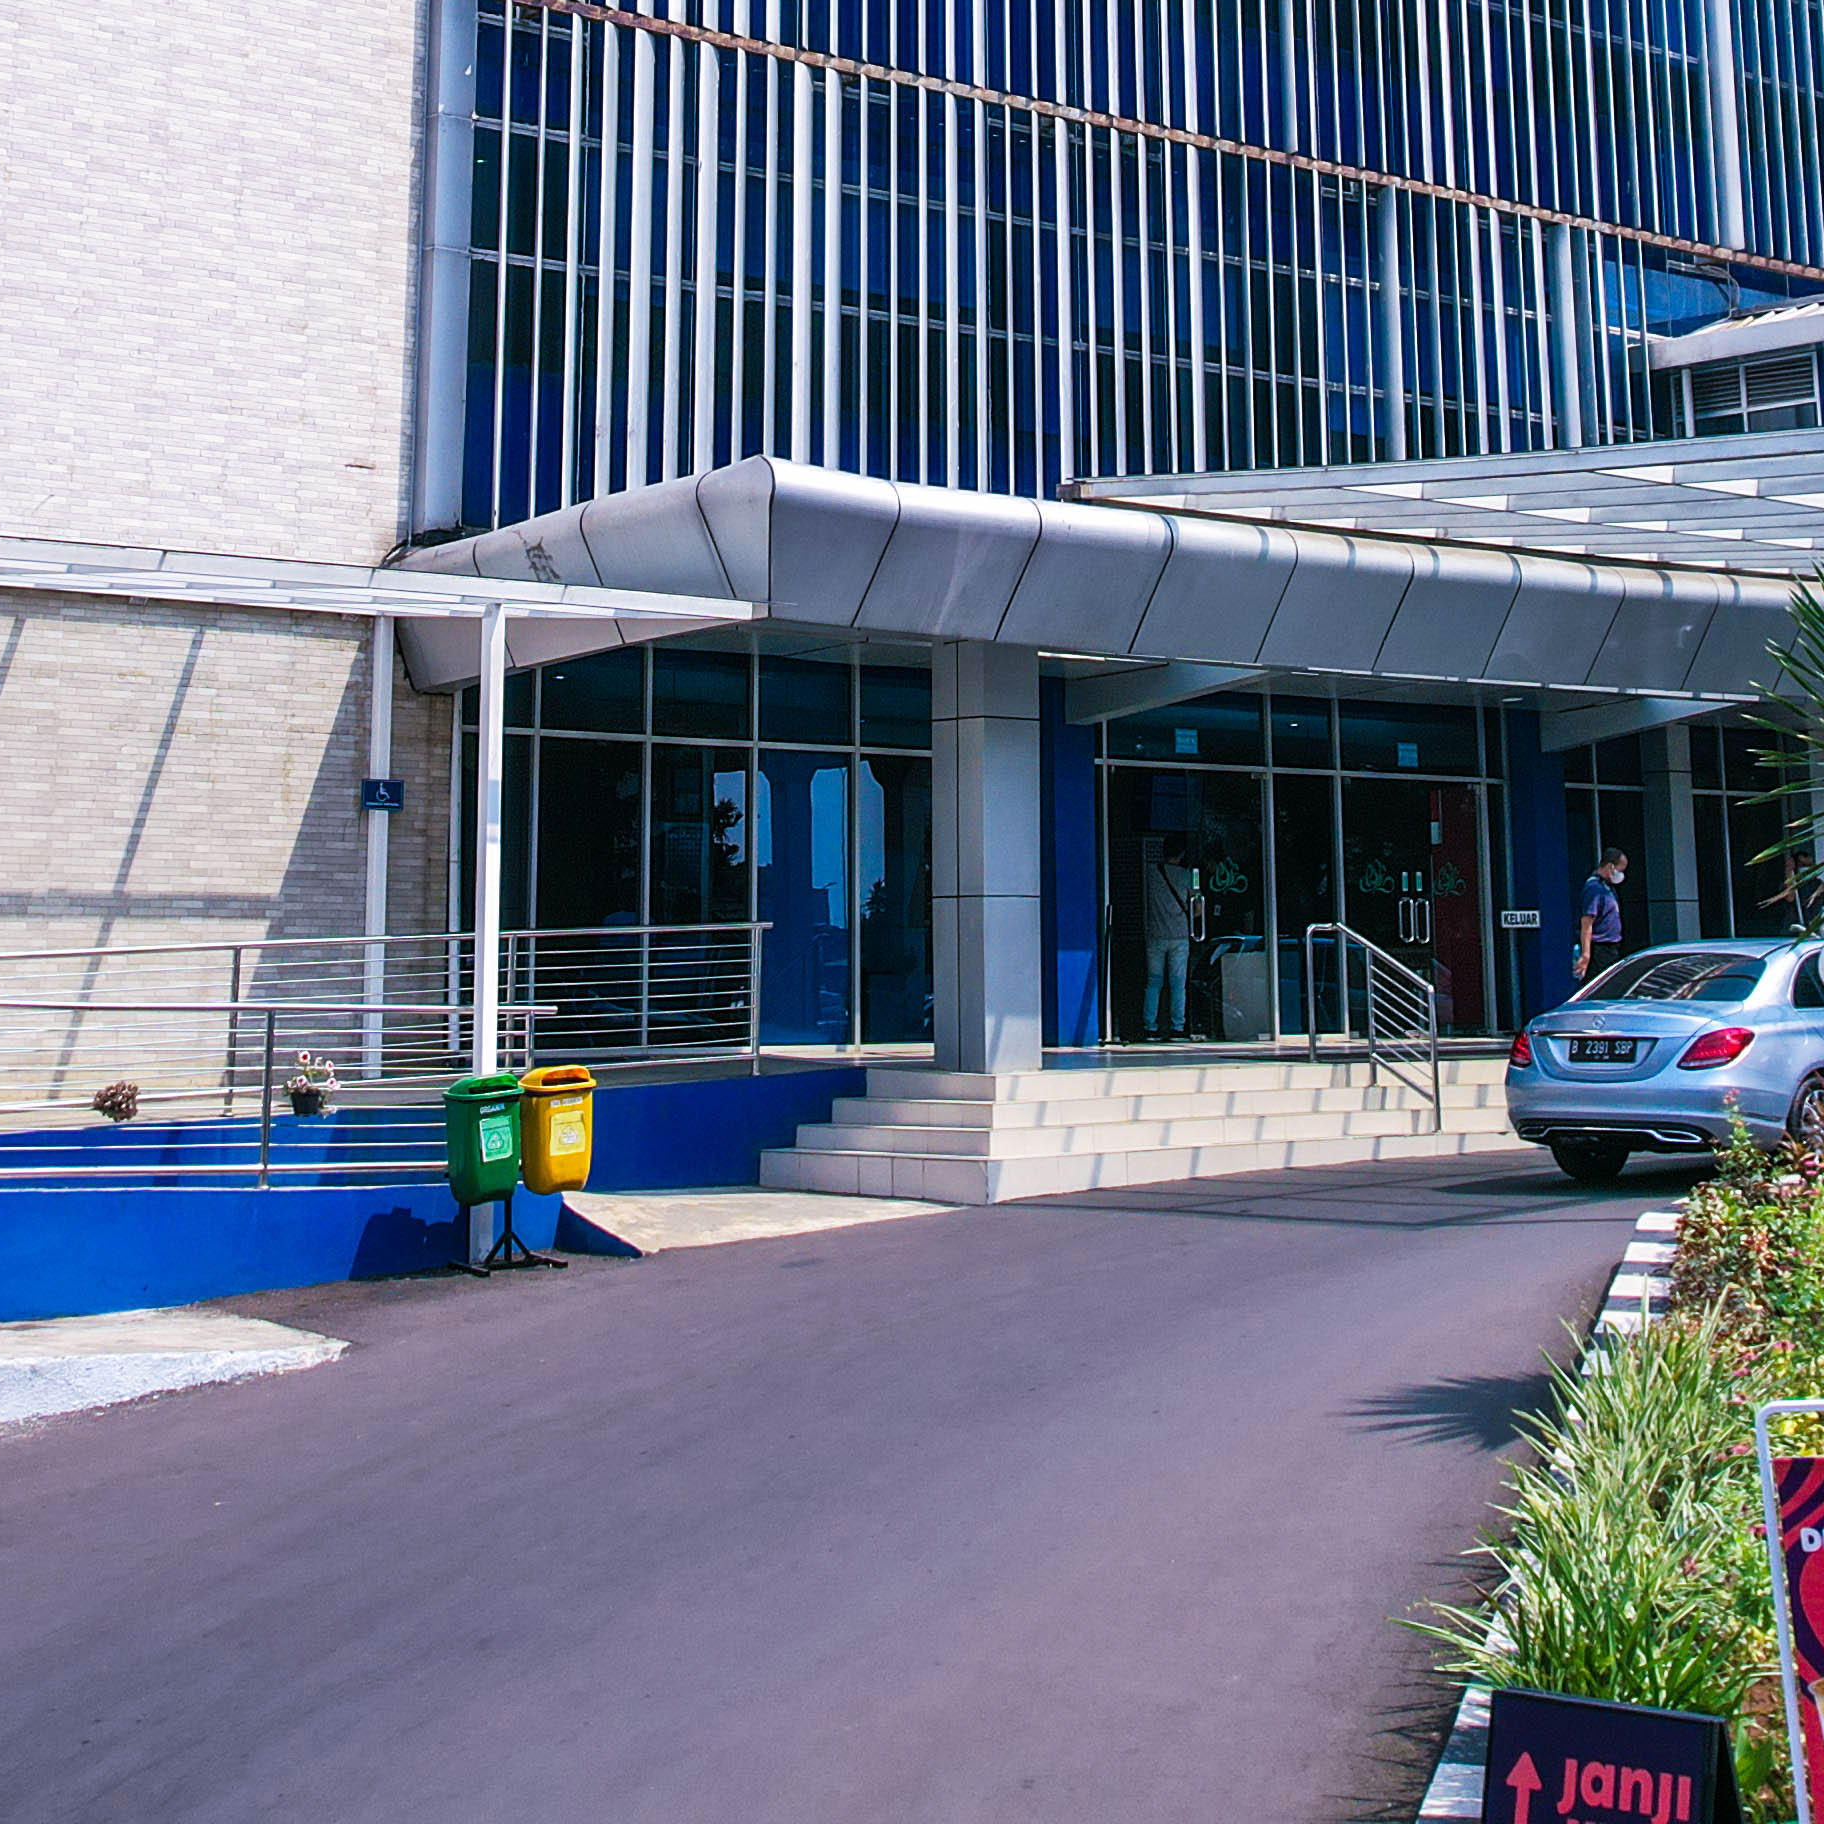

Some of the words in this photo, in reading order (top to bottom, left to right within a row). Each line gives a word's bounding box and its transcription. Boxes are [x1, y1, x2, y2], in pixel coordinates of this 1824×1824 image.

[1503, 912, 1538, 926] KELUAR
[1572, 1040, 1579, 1054] B
[1585, 1040, 1609, 1054] 2391
